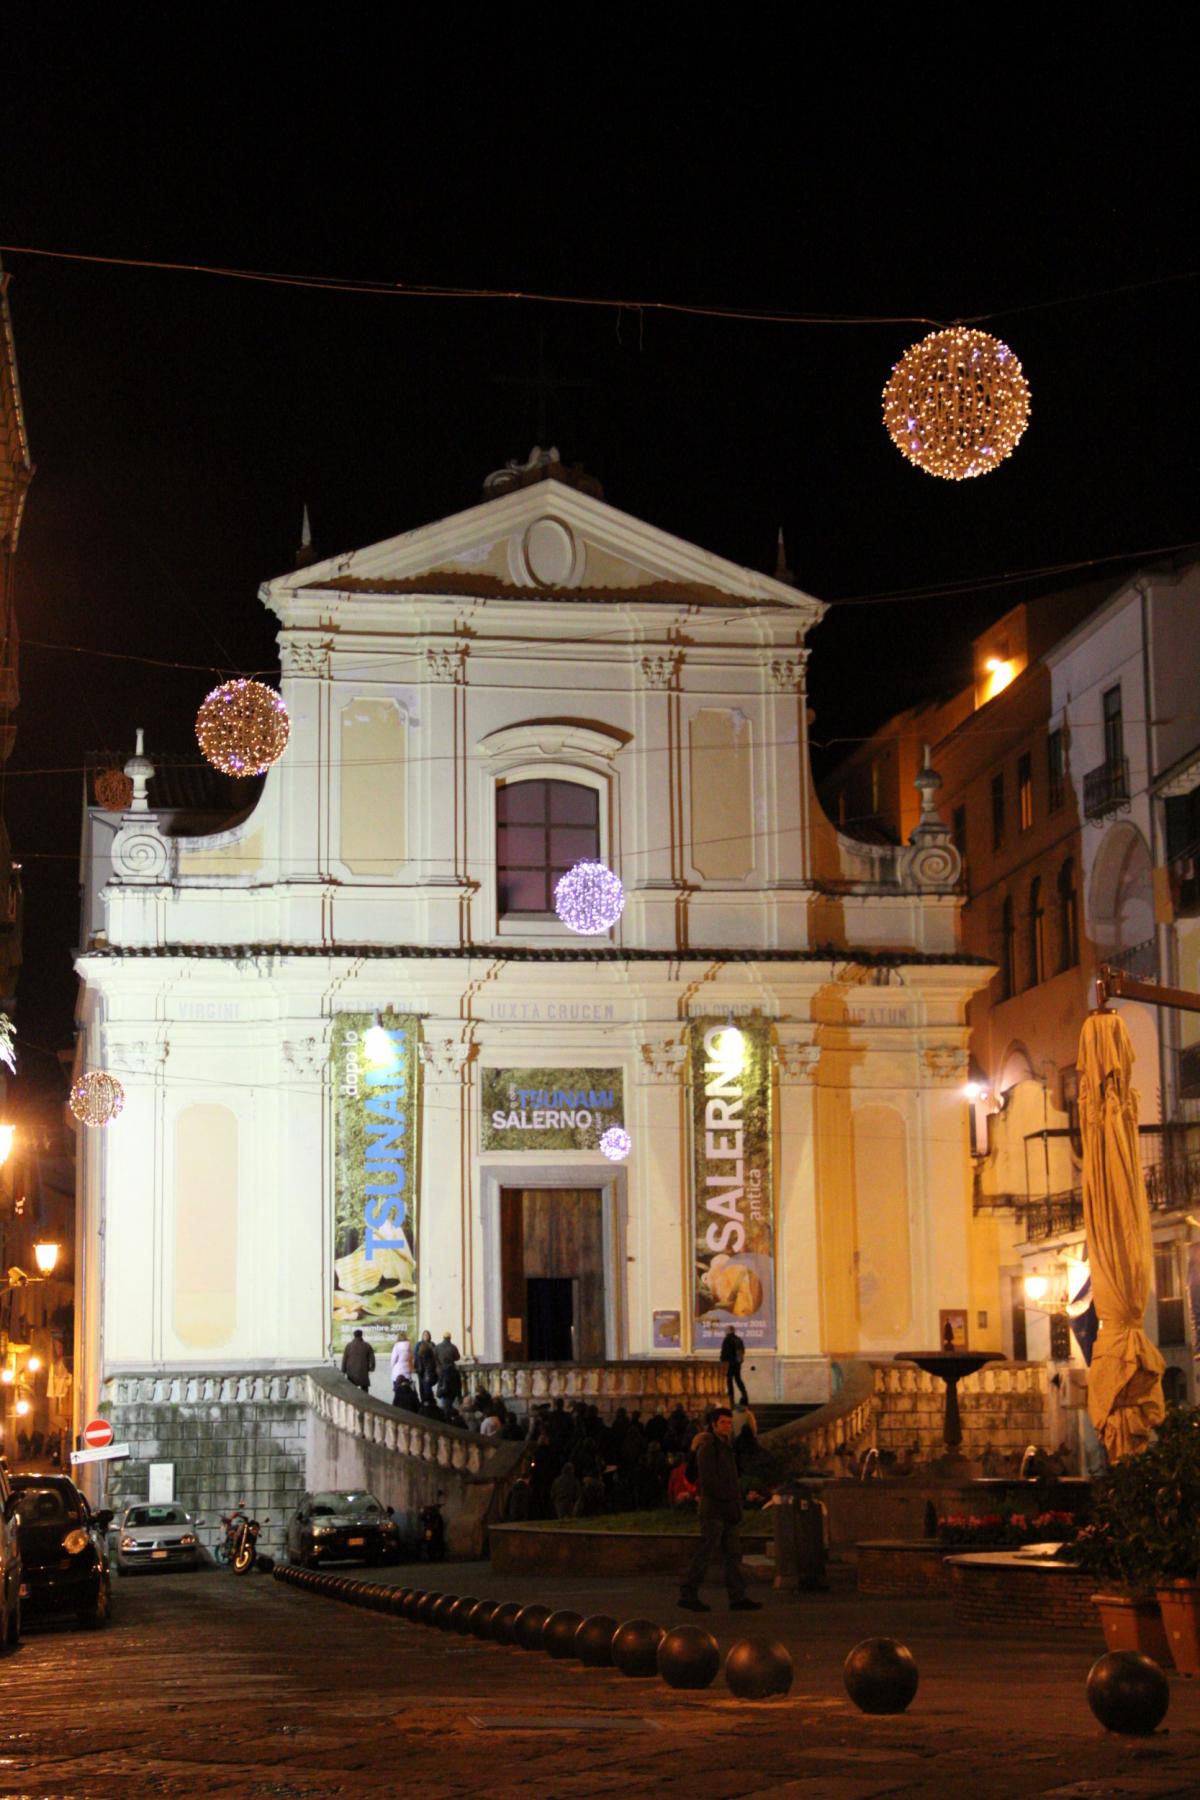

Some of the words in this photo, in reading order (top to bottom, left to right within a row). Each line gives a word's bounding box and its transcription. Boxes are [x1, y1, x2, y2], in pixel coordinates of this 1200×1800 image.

[178, 1002, 240, 1019] VIRGINI
[490, 1003, 540, 1019] IUXTA
[546, 1003, 614, 1019] CRUCEM
[843, 1007, 907, 1024] DICATUM
[342, 1030, 358, 1045] lo
[341, 1053, 360, 1096] dopo
[516, 1088, 614, 1109] TSUNAMI
[492, 1110, 592, 1130] SALERNO
[703, 1025, 745, 1253] SALERNO
[748, 1168, 761, 1220] antica
